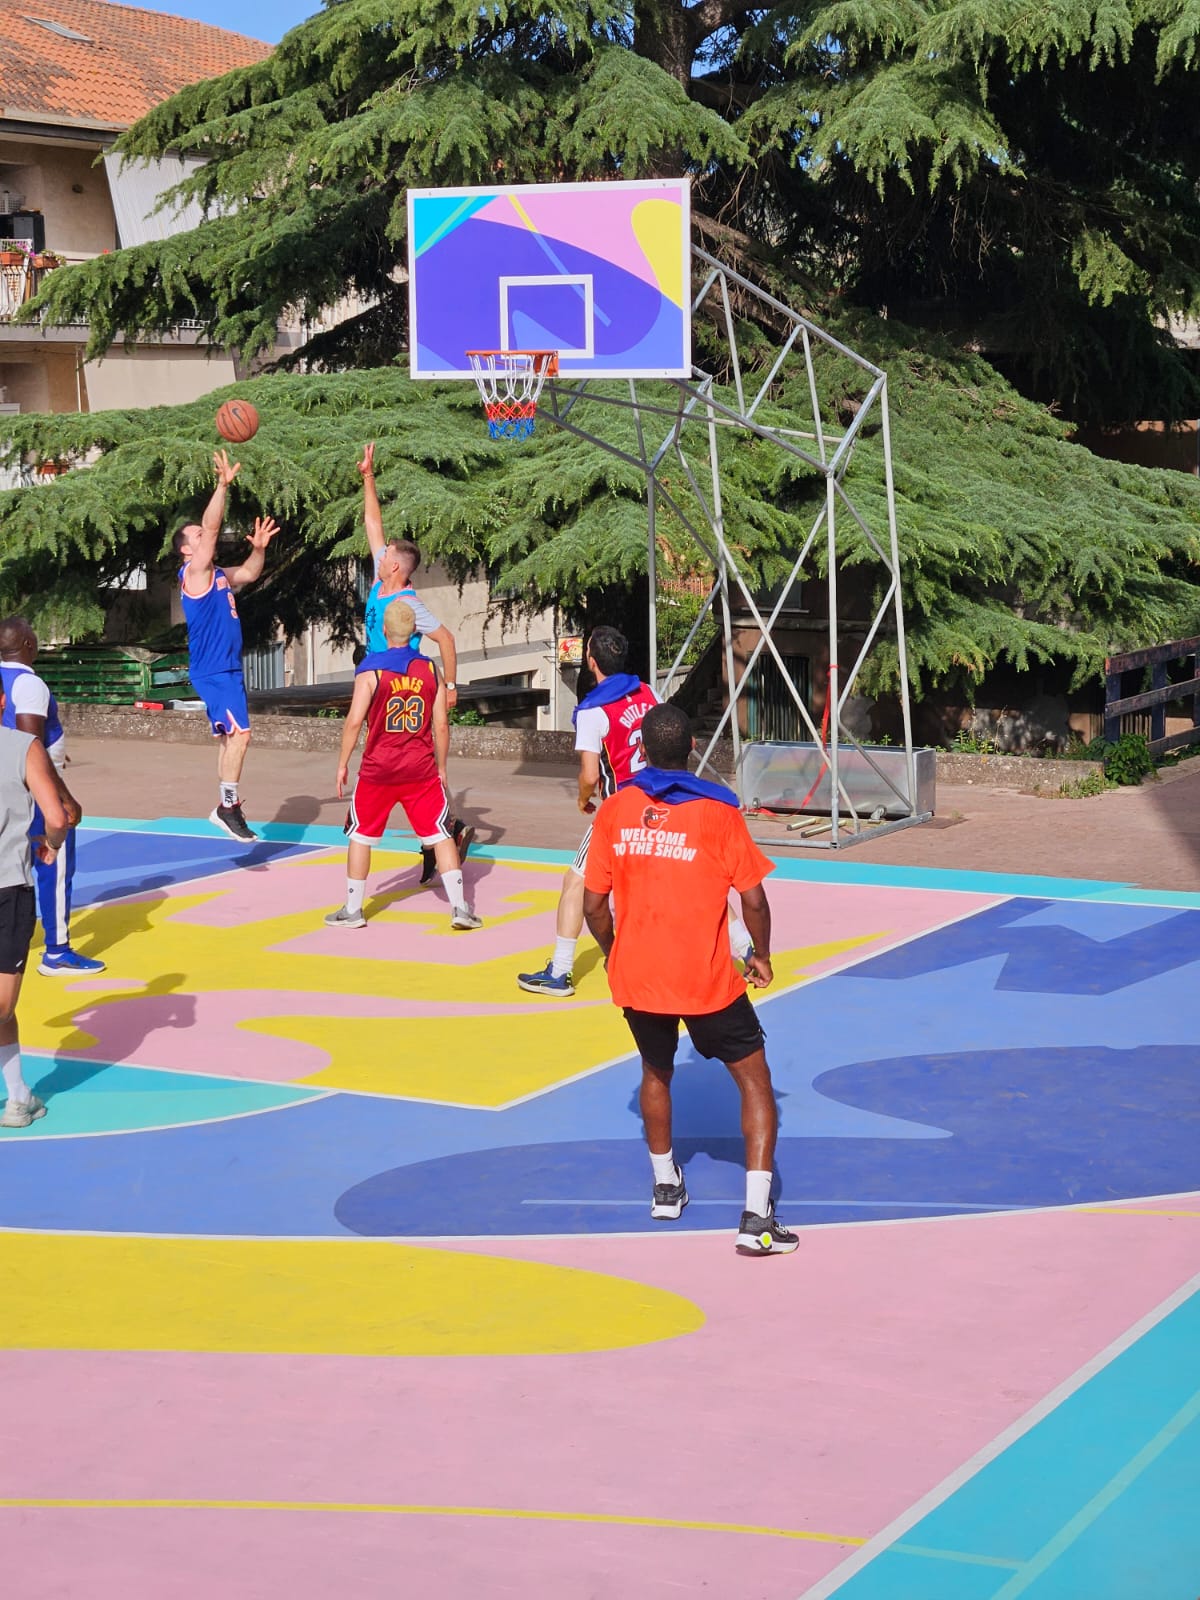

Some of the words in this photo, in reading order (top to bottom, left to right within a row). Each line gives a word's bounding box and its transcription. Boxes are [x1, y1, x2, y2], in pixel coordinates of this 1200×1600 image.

[390, 676, 424, 695] JAMES
[385, 695, 425, 734] 23
[620, 828, 687, 847] WELCOME
[612, 842, 626, 857] TO
[628, 841, 653, 856] THE
[654, 844, 697, 862] SHOW
